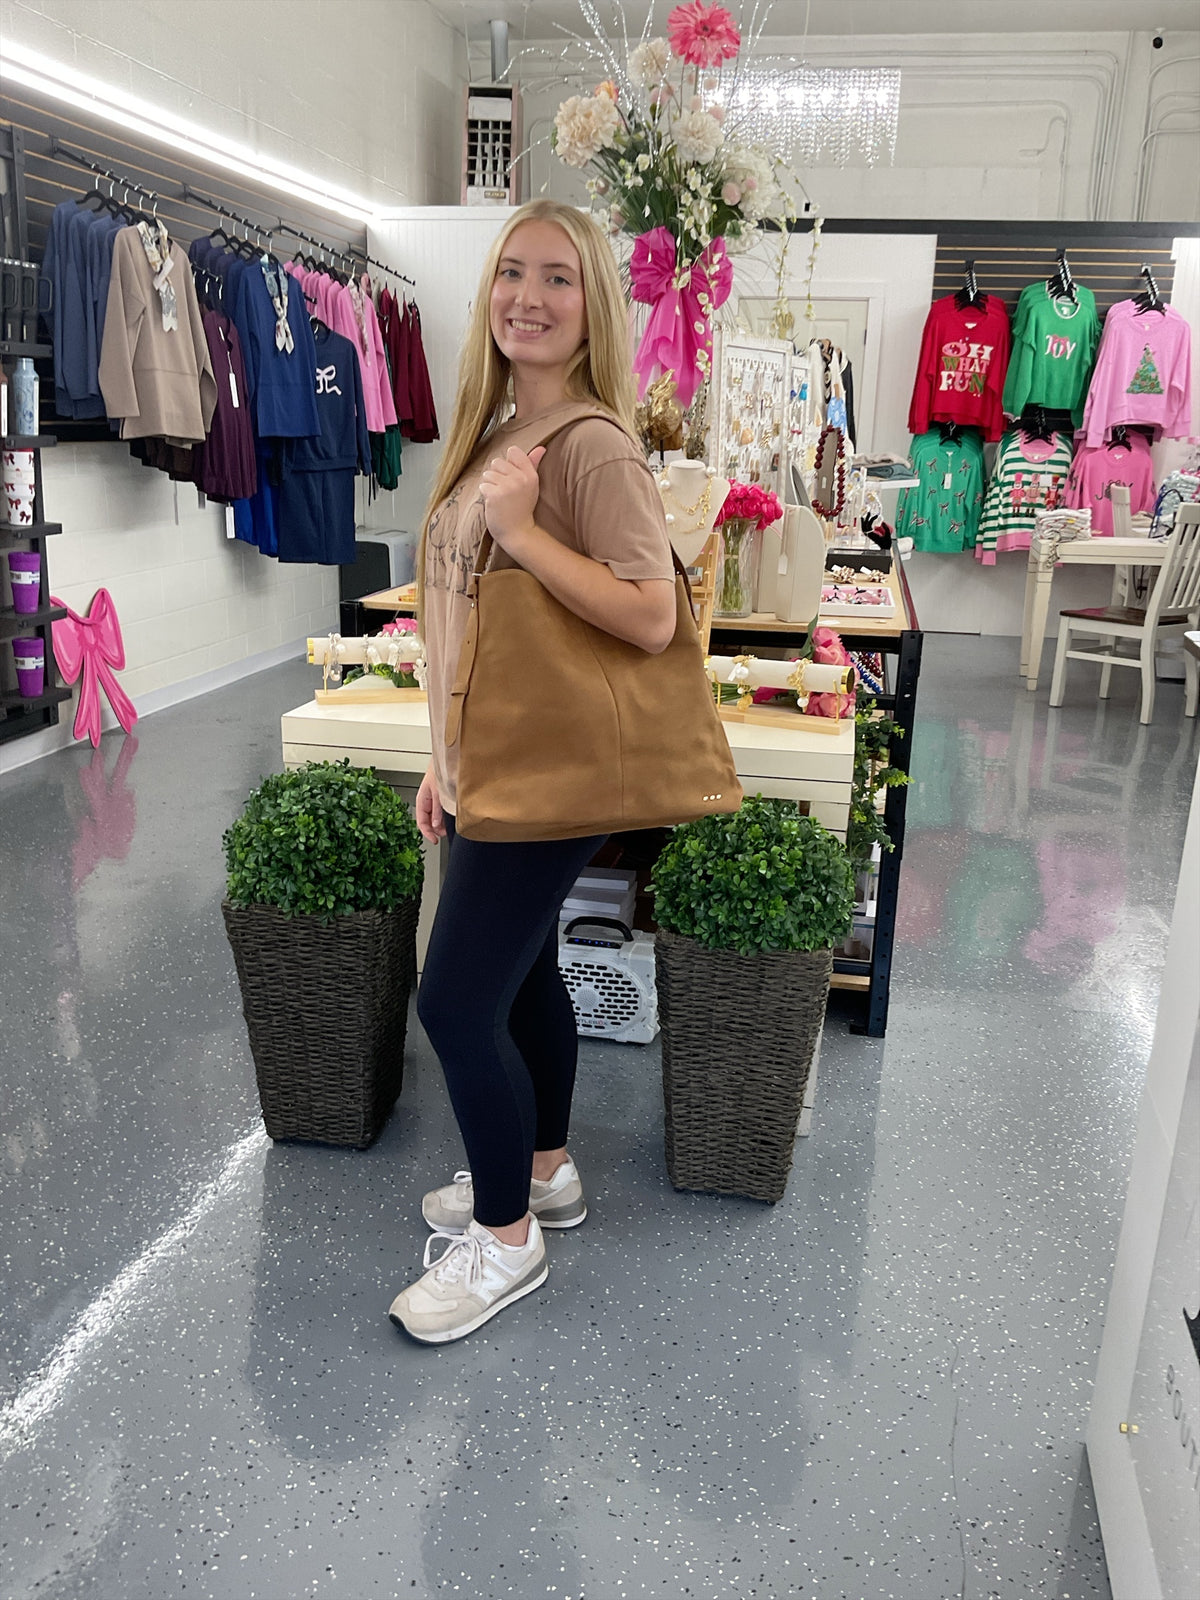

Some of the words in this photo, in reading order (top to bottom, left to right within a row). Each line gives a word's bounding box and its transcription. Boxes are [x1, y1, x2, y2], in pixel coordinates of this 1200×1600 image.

[942, 341, 994, 360] OH
[1045, 335, 1076, 360] JOY
[942, 357, 990, 374] WHAT
[939, 371, 986, 394] FUN
